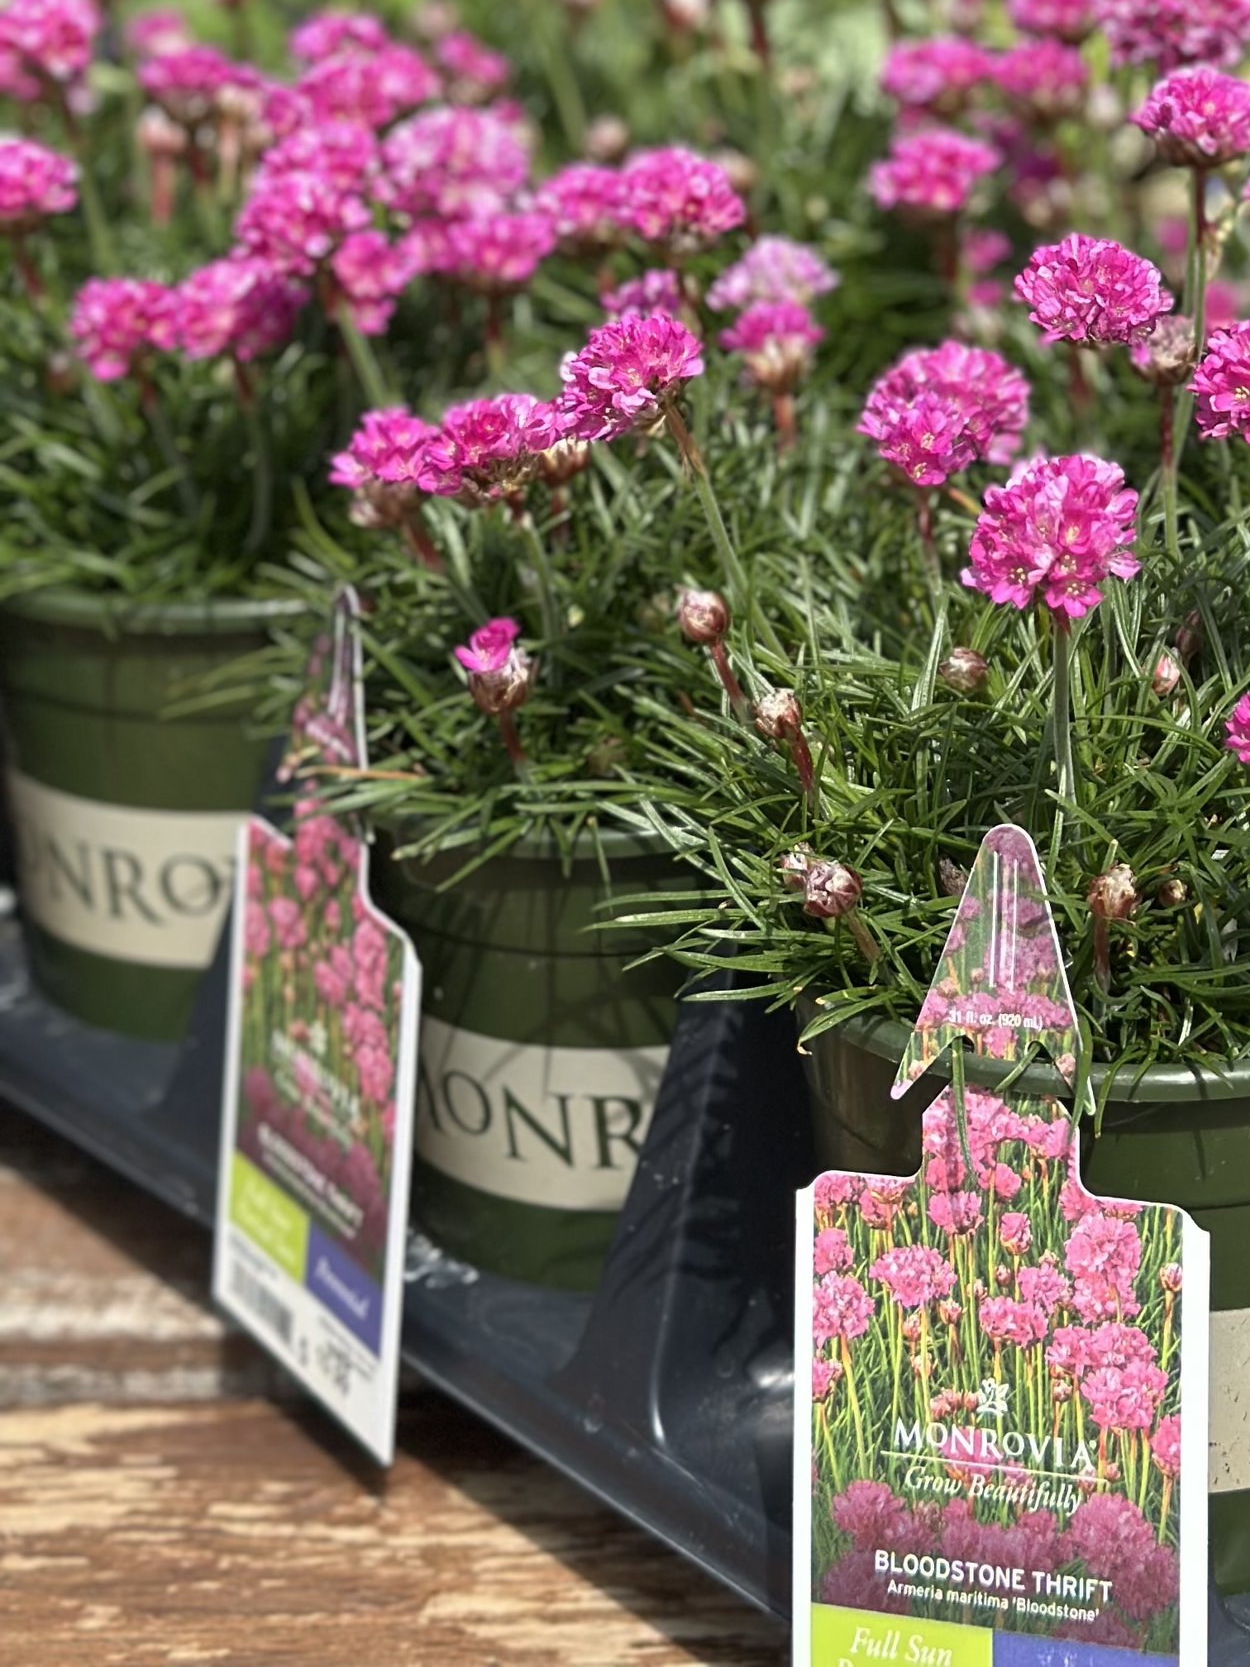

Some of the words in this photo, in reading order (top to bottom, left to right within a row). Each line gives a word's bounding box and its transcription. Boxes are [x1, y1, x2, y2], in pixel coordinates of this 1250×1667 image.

[949, 1010, 961, 1023] 31
[966, 1010, 977, 1024] fl.
[980, 1014, 996, 1025] oz.
[998, 1013, 1021, 1028] (920
[894, 1417, 1095, 1470] MONROVIA
[904, 1466, 963, 1495] Grow
[968, 1473, 1082, 1517] Beautifully
[874, 1550, 1025, 1591] BLOODSTONE
[1031, 1571, 1113, 1603] THRIFT
[887, 1580, 943, 1601] Armeria
[947, 1588, 1009, 1610] maritima
[1012, 1597, 1100, 1622] 'Bloodstone'
[849, 1627, 900, 1659] Full
[904, 1634, 953, 1667] Sun
